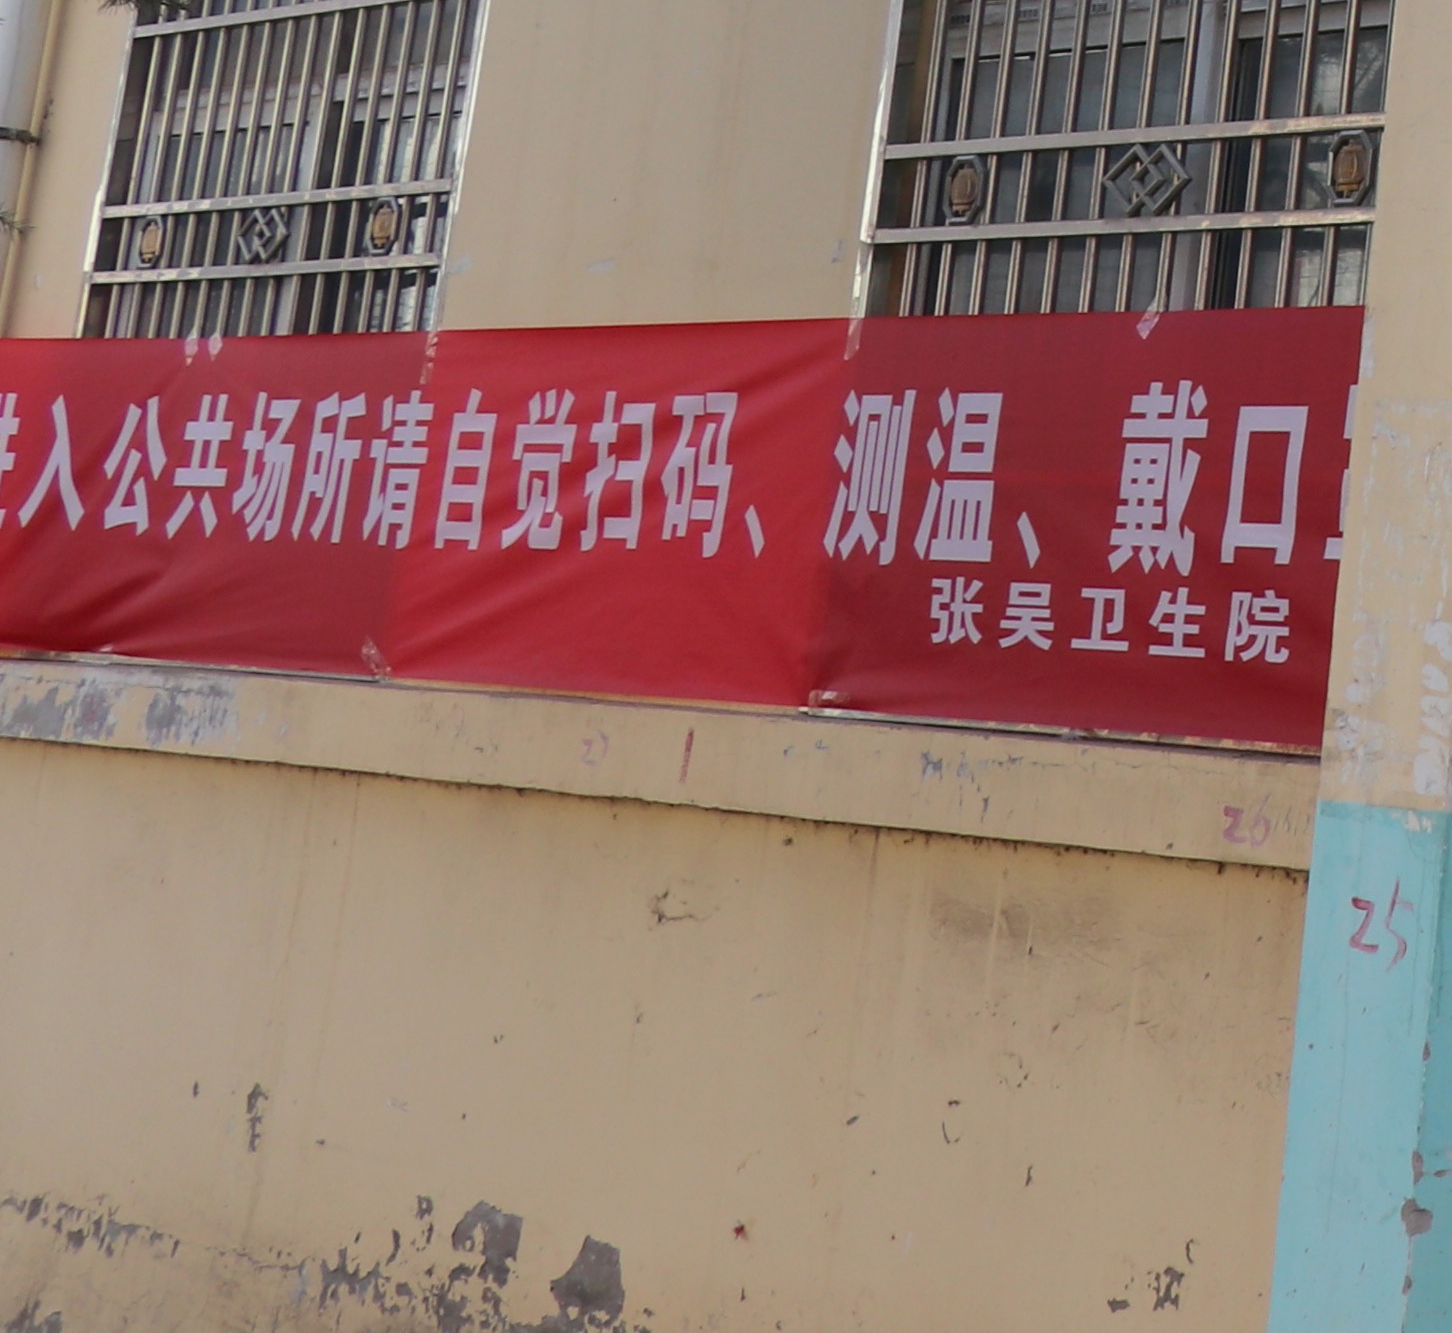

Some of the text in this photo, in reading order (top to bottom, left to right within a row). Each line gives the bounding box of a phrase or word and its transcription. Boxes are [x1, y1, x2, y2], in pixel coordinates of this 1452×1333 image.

[0, 379, 1357, 577] 入公共场所请自觉扫码、测温、戴口
[929, 577, 1294, 664] 张吴卫生院
